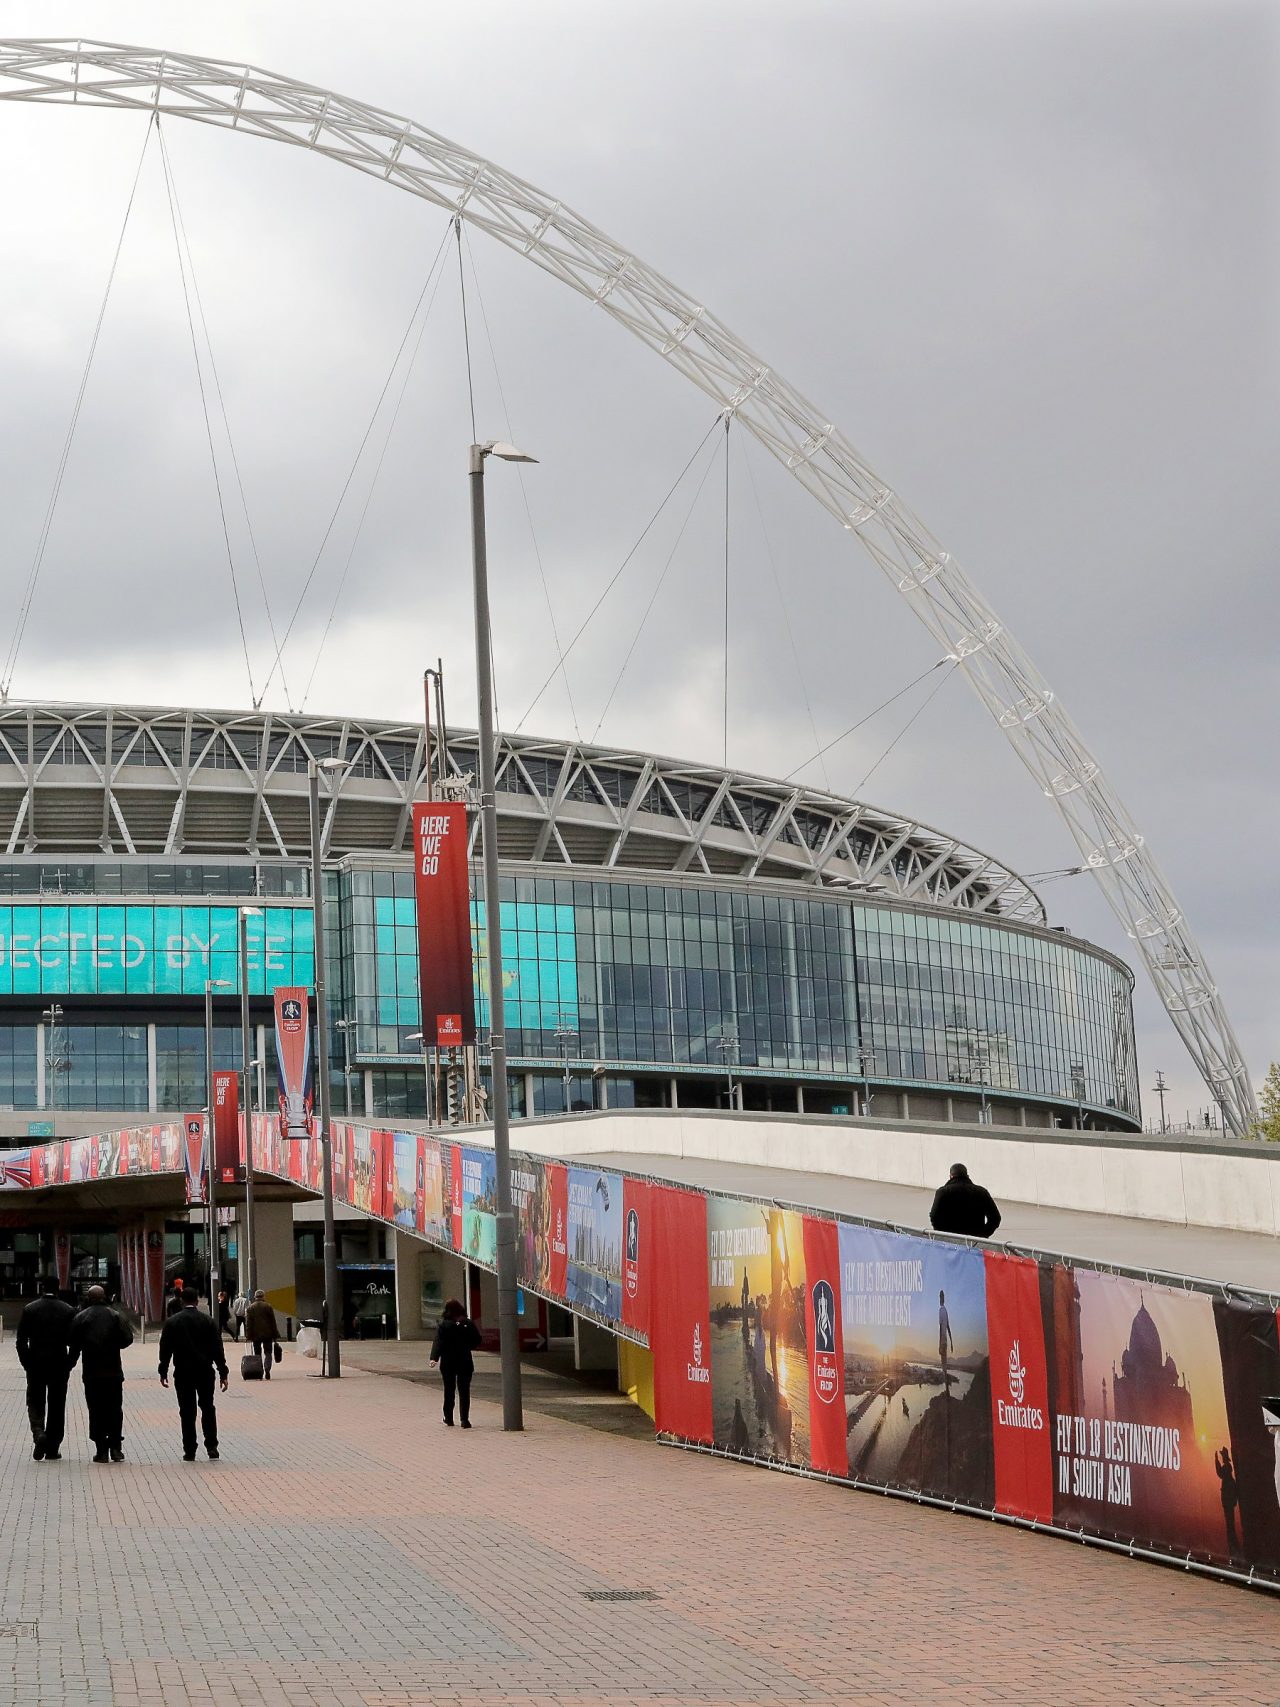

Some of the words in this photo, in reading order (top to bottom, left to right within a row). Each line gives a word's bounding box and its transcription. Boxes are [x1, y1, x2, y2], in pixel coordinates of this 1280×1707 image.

[420, 816, 451, 835] HERE
[422, 836, 441, 855] WE
[422, 856, 439, 875] GO
[166, 933, 220, 969] BY
[216, 1077, 230, 1087] HERE
[217, 1087, 226, 1096] WE
[845, 1262, 855, 1292] FLY
[856, 1262, 864, 1292] TO
[866, 1261, 873, 1292] 15
[875, 1260, 923, 1292] DESTINATIONS
[895, 1295, 911, 1327] EAST
[688, 1363, 709, 1383] Emirates
[998, 1400, 1043, 1430] Emirates
[1056, 1414, 1072, 1453] FLY
[1074, 1416, 1086, 1456] TO
[1089, 1418, 1100, 1458] 18
[1104, 1420, 1181, 1471] DESTINATIONS
[1059, 1456, 1069, 1493] IN
[1073, 1458, 1104, 1501] SOUTH
[1107, 1464, 1132, 1507] ASIA
